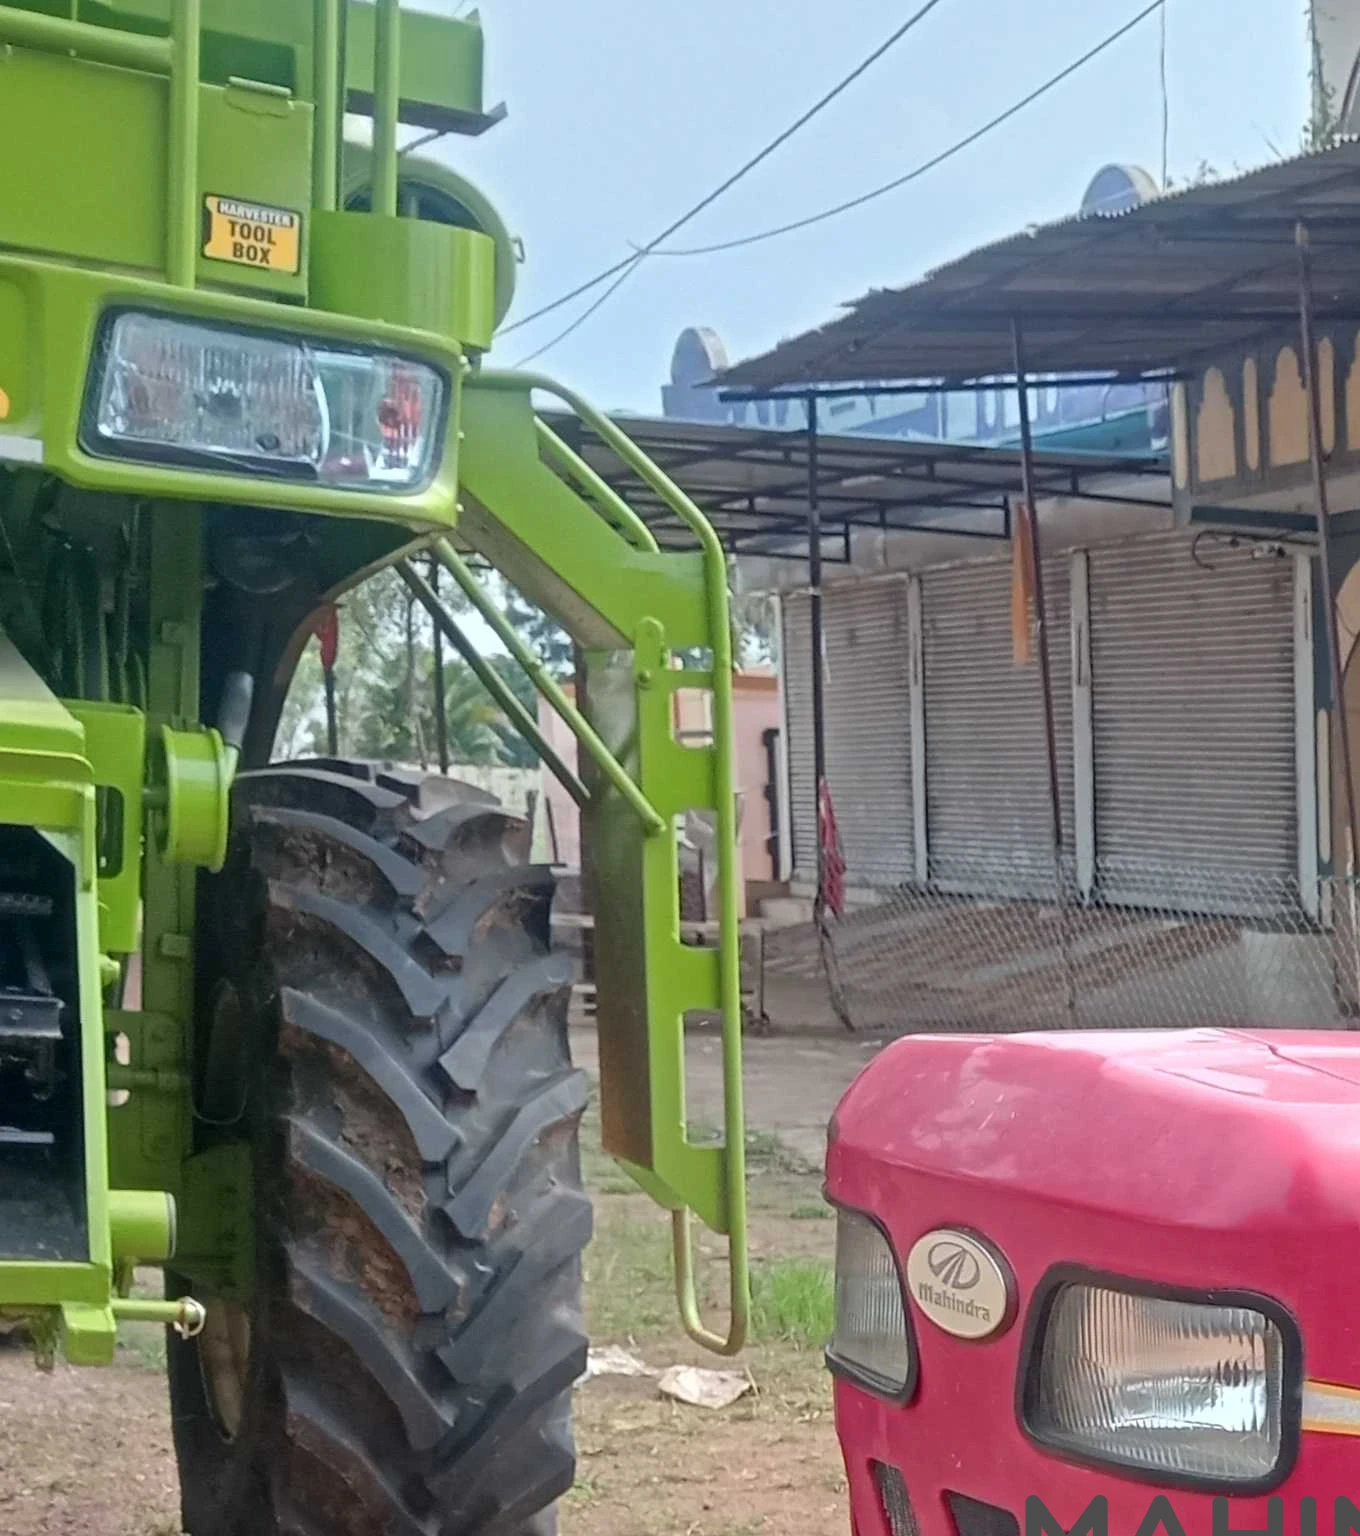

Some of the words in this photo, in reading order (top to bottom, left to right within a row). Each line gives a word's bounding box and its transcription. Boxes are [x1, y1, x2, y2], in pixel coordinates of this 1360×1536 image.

[219, 202, 292, 227] HARVESTER
[229, 220, 276, 246] TOOL
[233, 241, 272, 265] BOX
[918, 1280, 992, 1322] Mahindra
